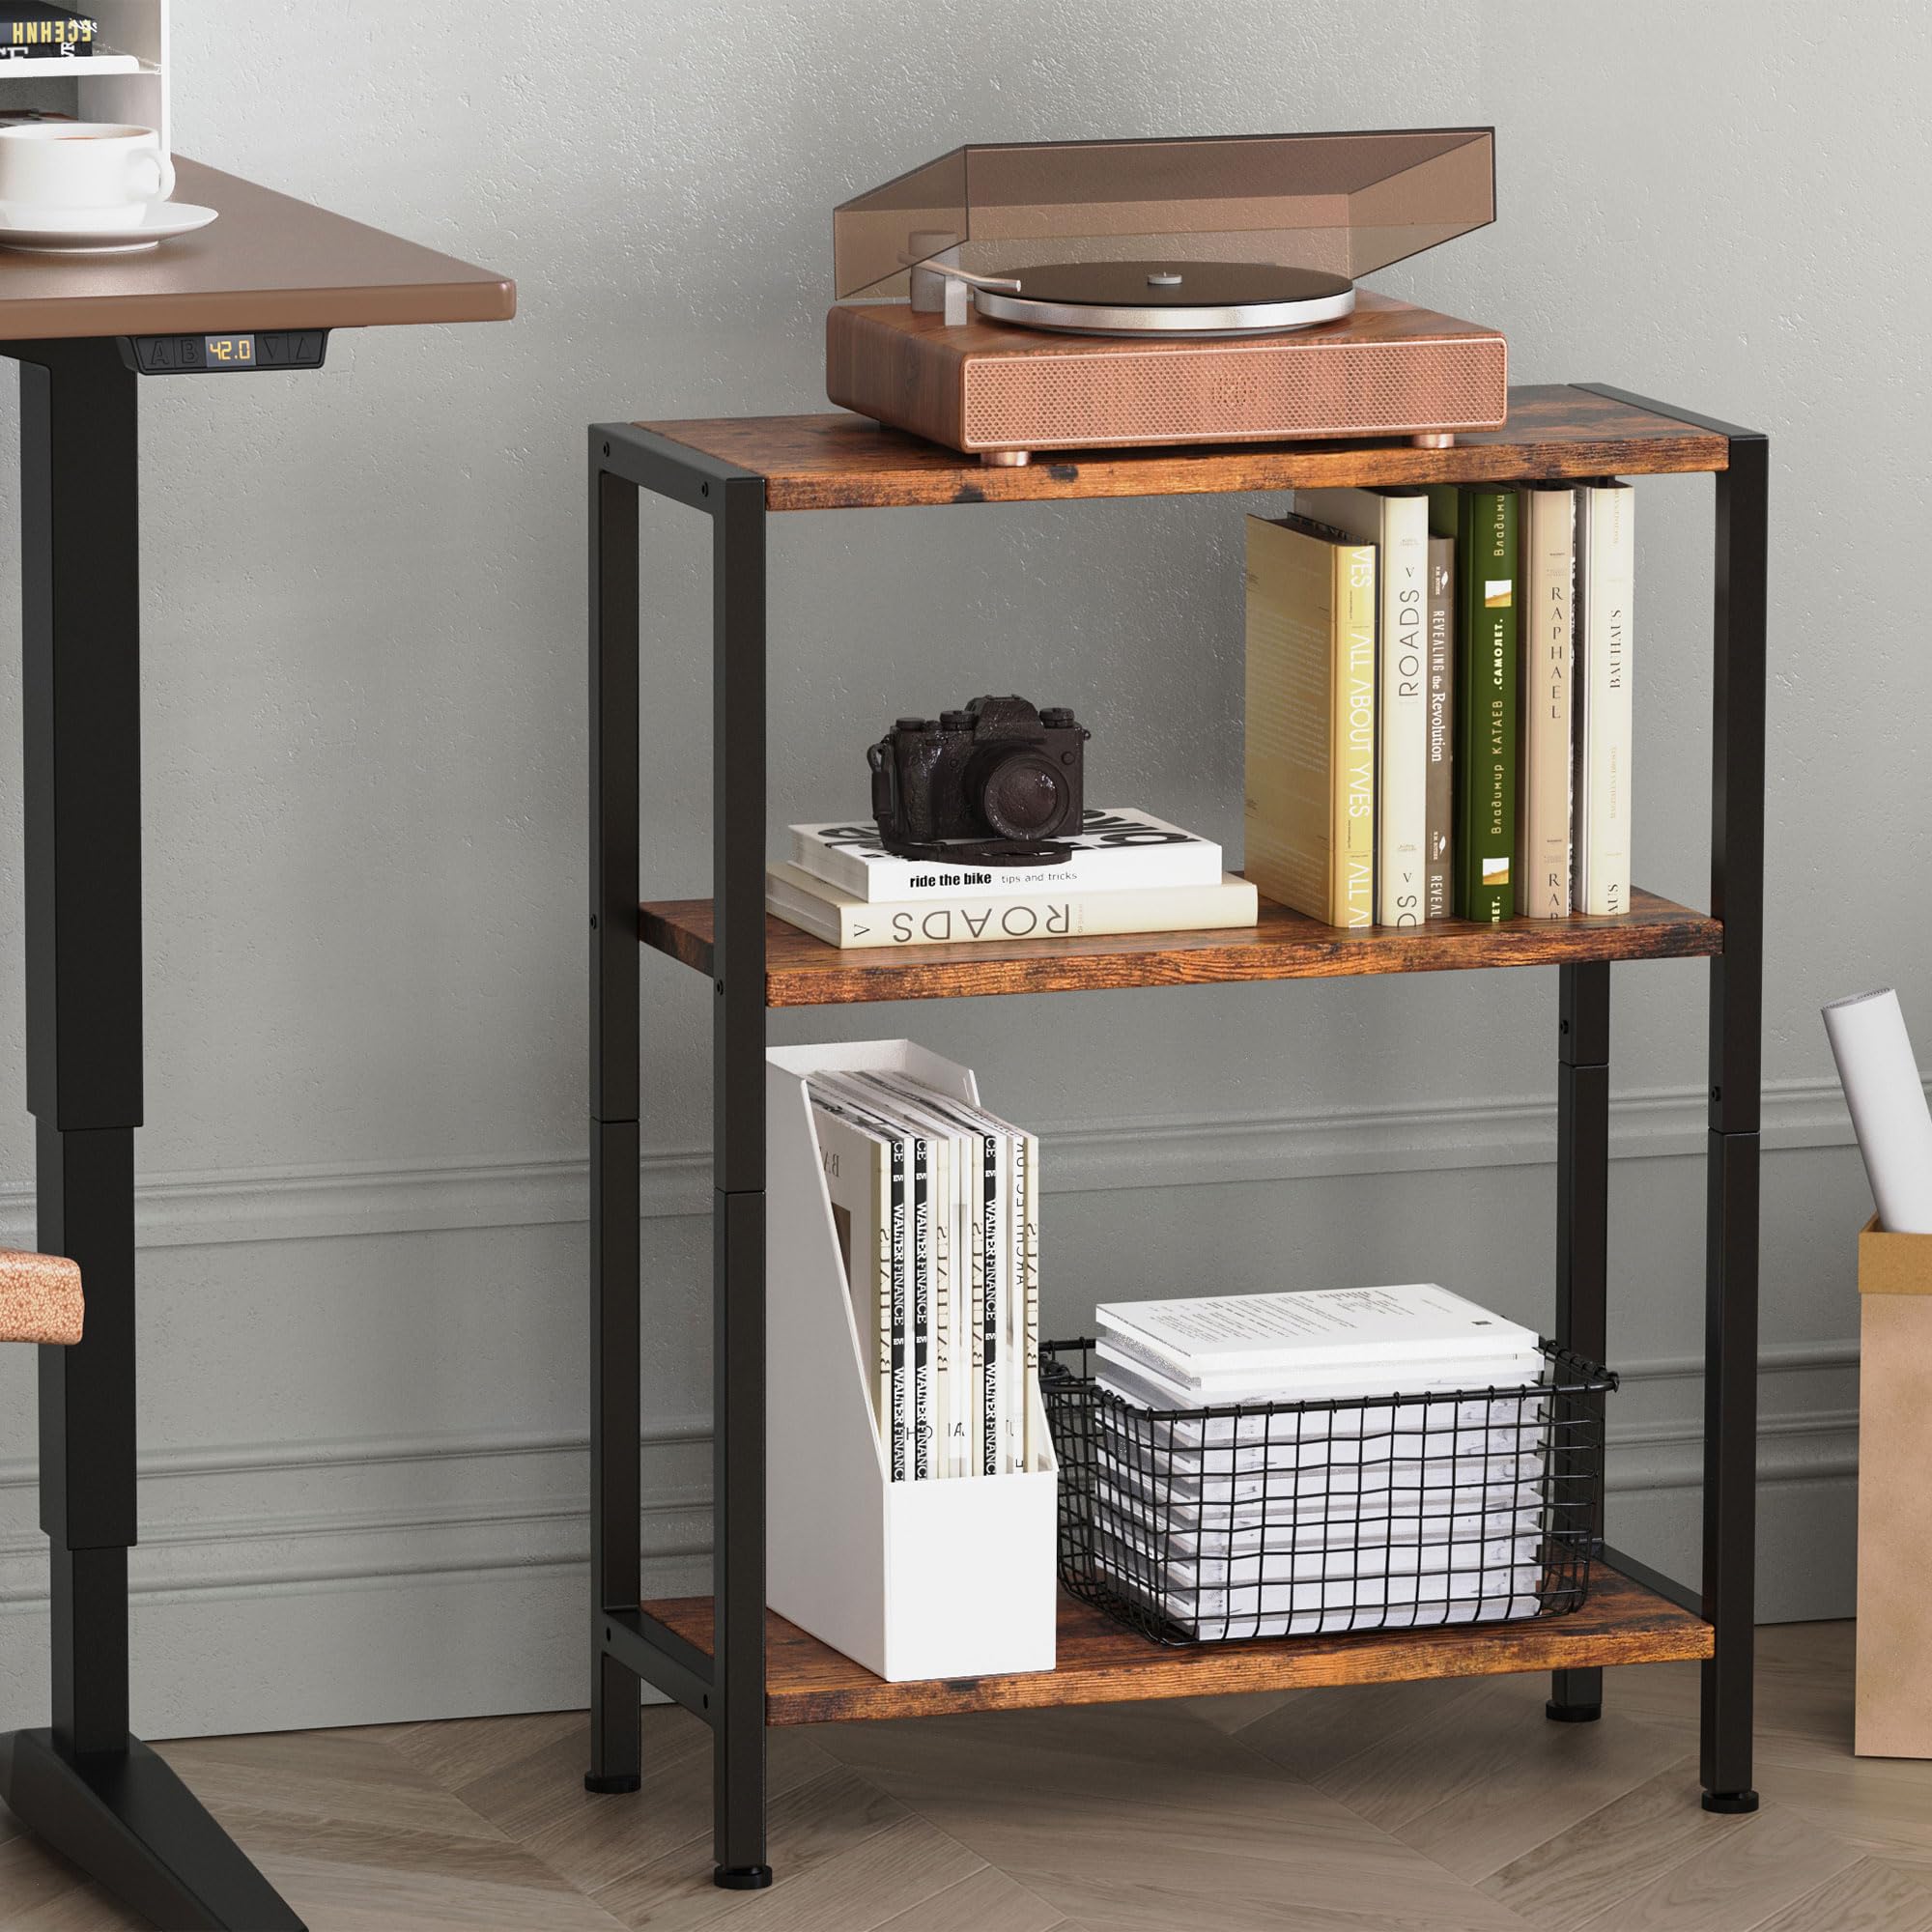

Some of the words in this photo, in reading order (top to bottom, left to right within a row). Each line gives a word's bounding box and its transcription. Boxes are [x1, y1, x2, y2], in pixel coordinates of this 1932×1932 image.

[210, 340, 250, 360] 42.0
[1350, 633, 1372, 671] ALL
[1399, 589, 1420, 696] ROADS
[1433, 610, 1445, 671] REVEALING
[1550, 586, 1563, 719] RAPHAEL
[1609, 610, 1622, 689] BAUHAUS
[1432, 675, 1442, 690] the
[1350, 678, 1373, 752] ABOUT
[1432, 692, 1446, 762] Revolution
[1492, 700, 1503, 755] КАТАЕВ
[1349, 763, 1371, 817] YVES
[1491, 764, 1504, 835] Владимир
[910, 873, 936, 888] ride
[939, 872, 961, 887] the
[963, 872, 992, 886] bike
[1001, 875, 1021, 884] tips
[1025, 873, 1044, 883] and
[1048, 871, 1077, 881] tricks
[1348, 862, 1370, 901] ALL
[1430, 875, 1443, 918] REVEAL
[893, 903, 1069, 943] ROADS
[894, 1263, 904, 1326] FINANCE
[917, 1262, 927, 1324] FINANCE
[985, 1258, 997, 1321] FINANCE
[894, 1426, 905, 1482] FINANC
[917, 1424, 927, 1481] FINANC
